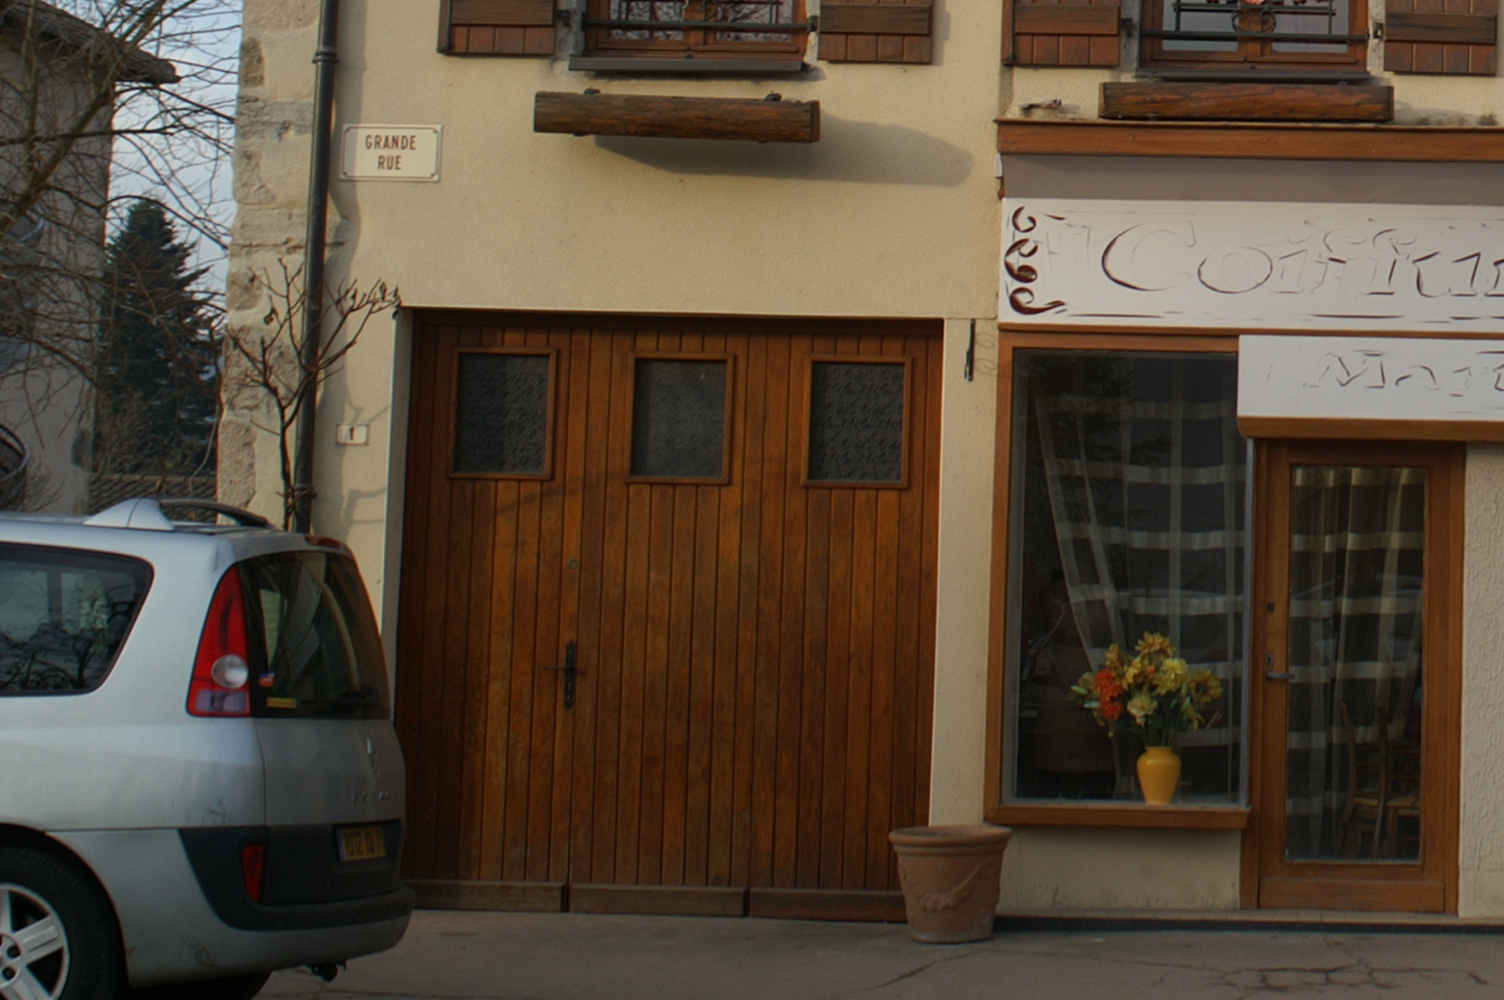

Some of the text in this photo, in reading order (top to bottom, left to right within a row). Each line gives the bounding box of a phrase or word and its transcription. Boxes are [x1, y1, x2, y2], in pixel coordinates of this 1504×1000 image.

[364, 133, 417, 151] GRANDE
[377, 154, 403, 171] RUE
[350, 426, 355, 441] 1
